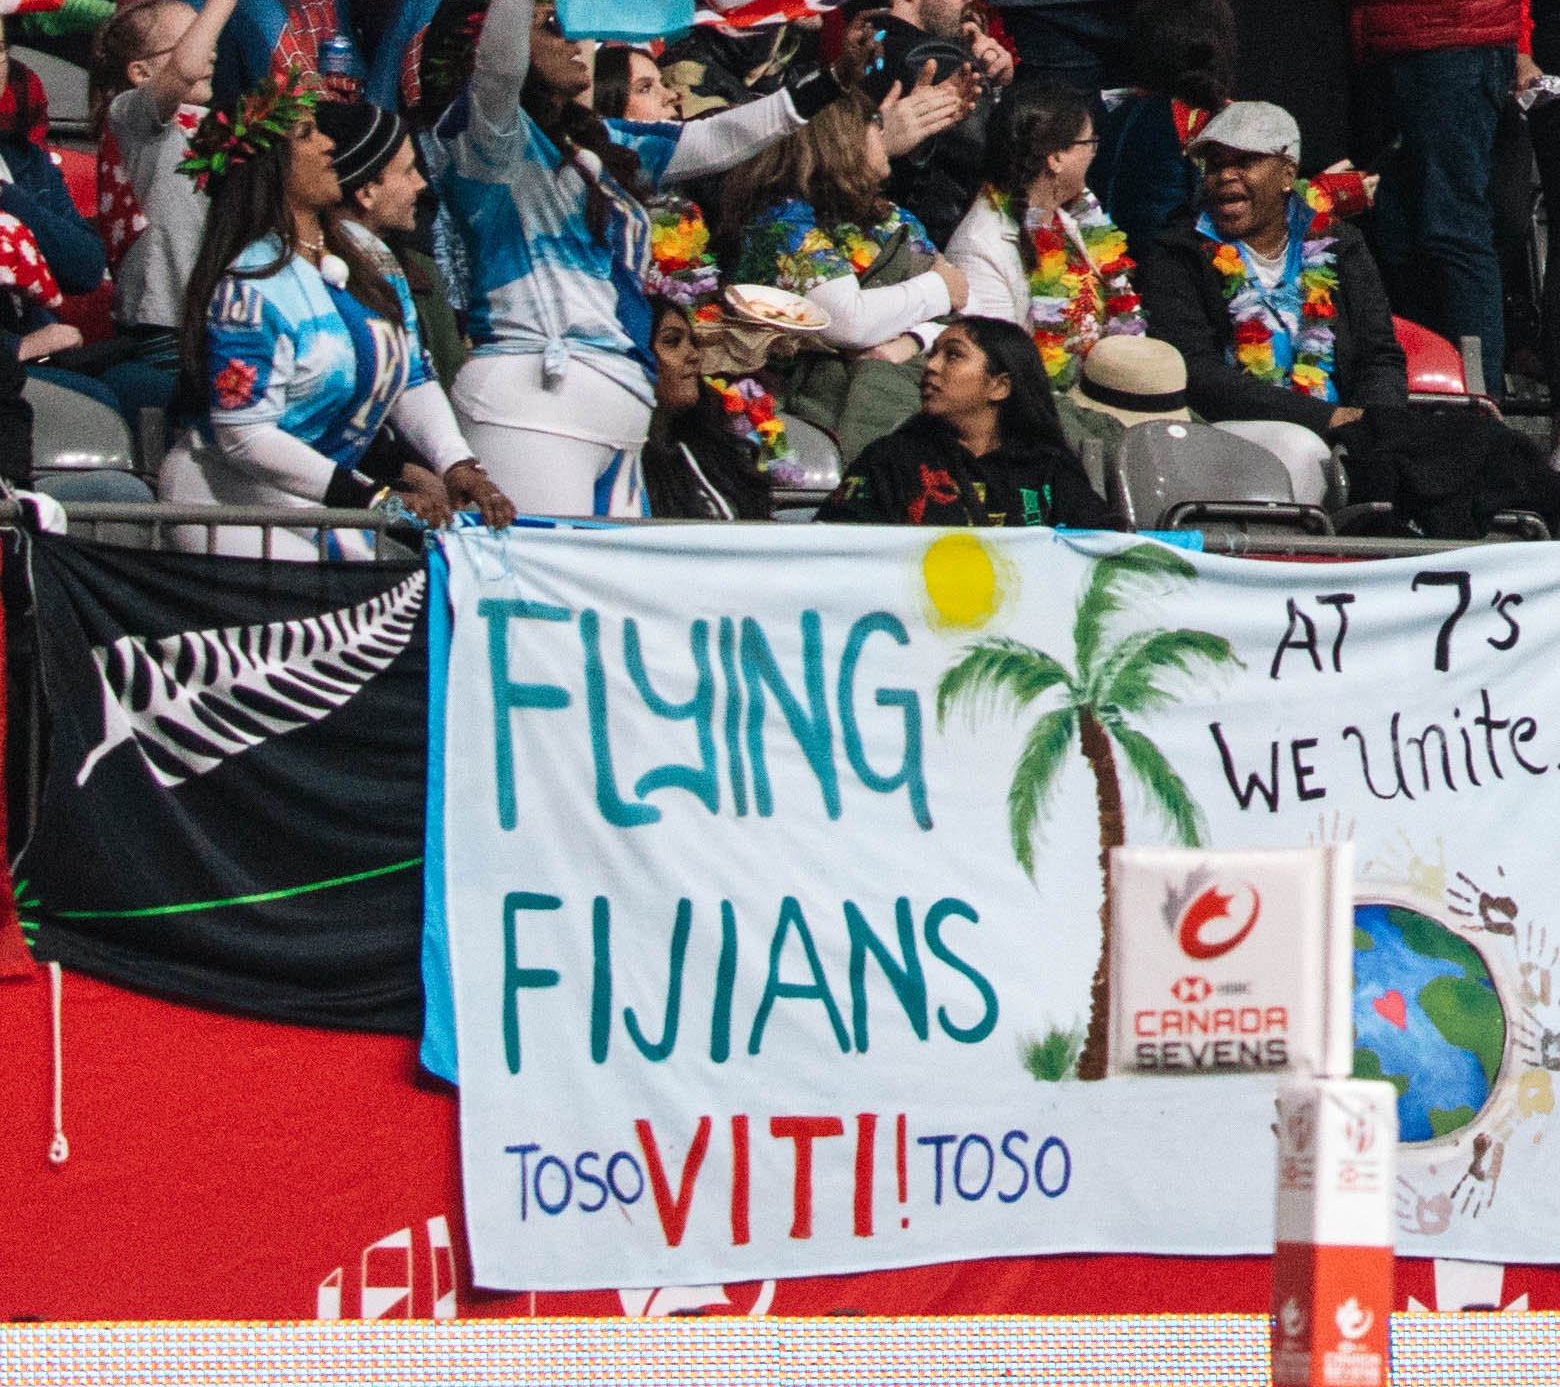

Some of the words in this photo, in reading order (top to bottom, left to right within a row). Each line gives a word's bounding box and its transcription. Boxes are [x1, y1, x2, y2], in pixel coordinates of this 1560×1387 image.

[1272, 593, 1355, 680] AT
[1413, 570, 1521, 673] 7's
[478, 597, 933, 831] FLYING
[1212, 722, 1329, 814] WE
[501, 890, 1000, 1075] FIJIANS
[1134, 1007, 1288, 1037] CANADA
[1135, 1039, 1288, 1070] SEVENS
[506, 1140, 645, 1220] TOSO
[636, 1113, 911, 1247] VITI!
[917, 1130, 1072, 1206] TOSO
